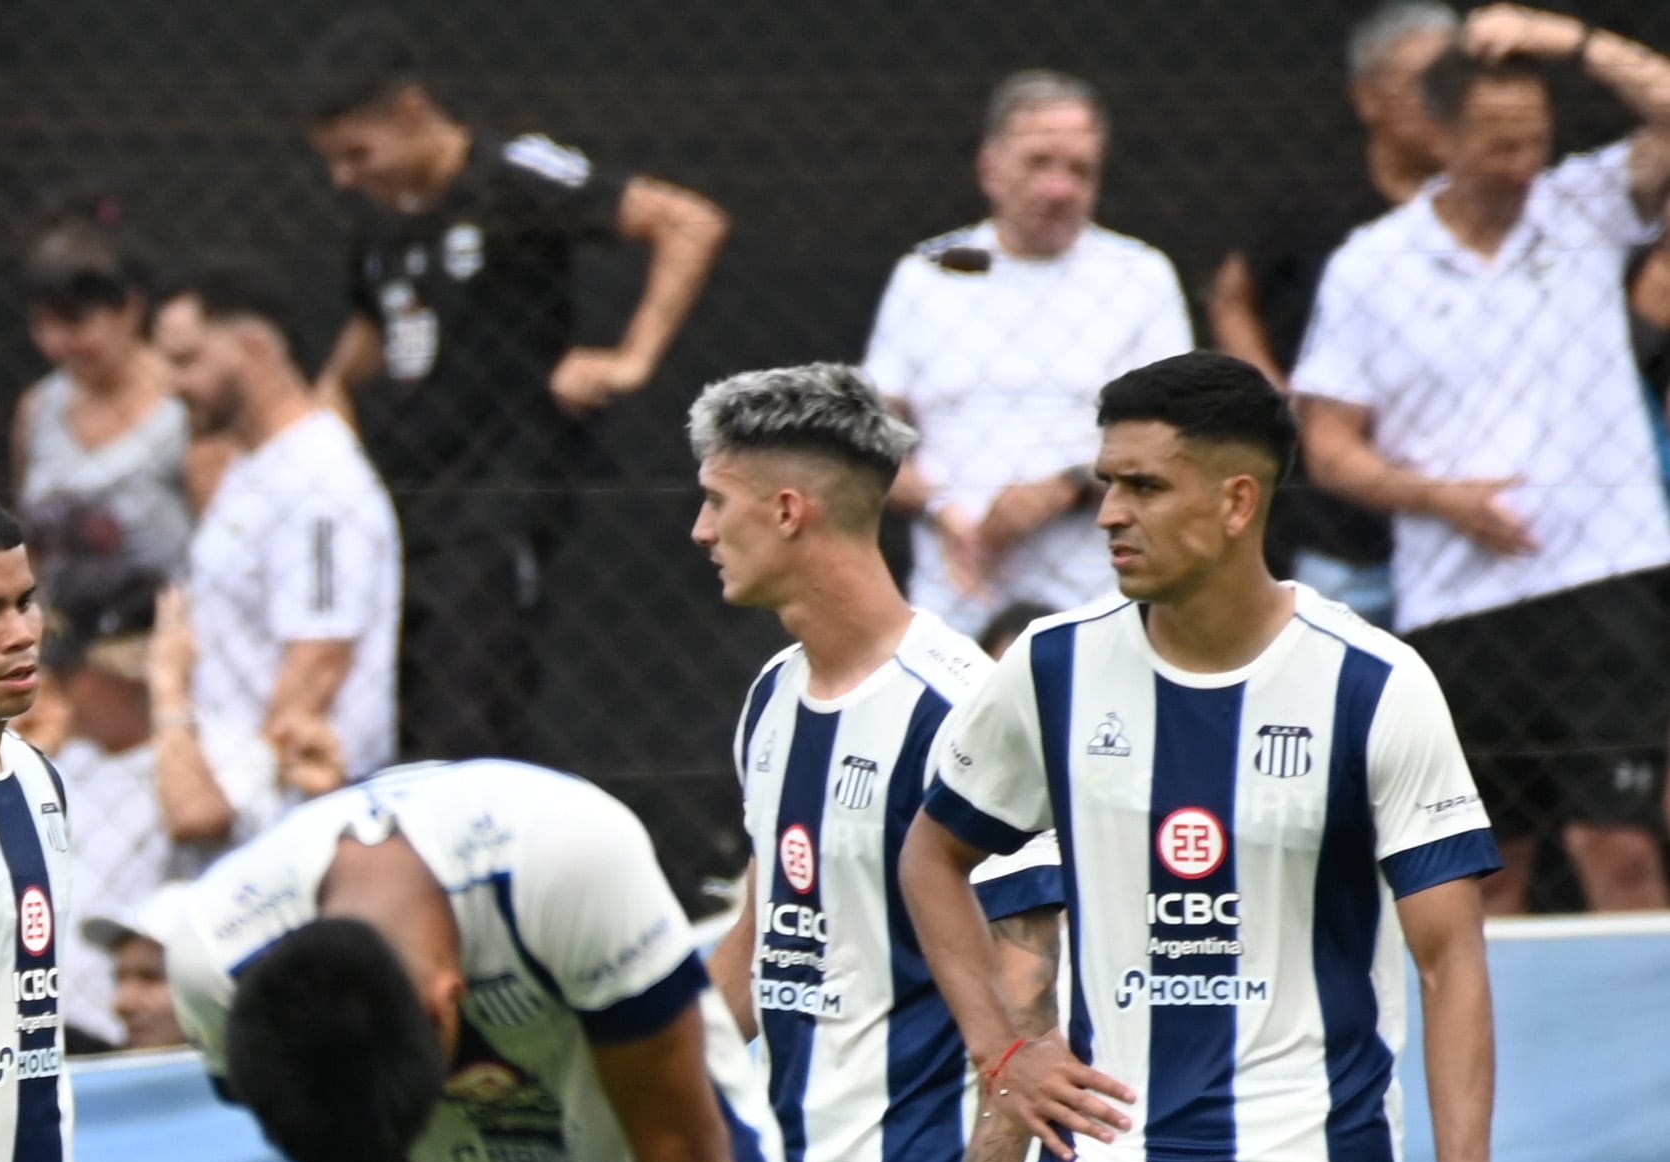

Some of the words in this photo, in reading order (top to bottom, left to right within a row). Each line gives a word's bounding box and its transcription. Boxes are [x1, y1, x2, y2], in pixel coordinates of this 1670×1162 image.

[762, 902, 828, 943] ICBC
[1146, 893, 1241, 925] ICBC
[1146, 937, 1244, 959] Argentina
[12, 967, 59, 1001] ICBC
[1150, 979, 1267, 1000] HOLCIM
